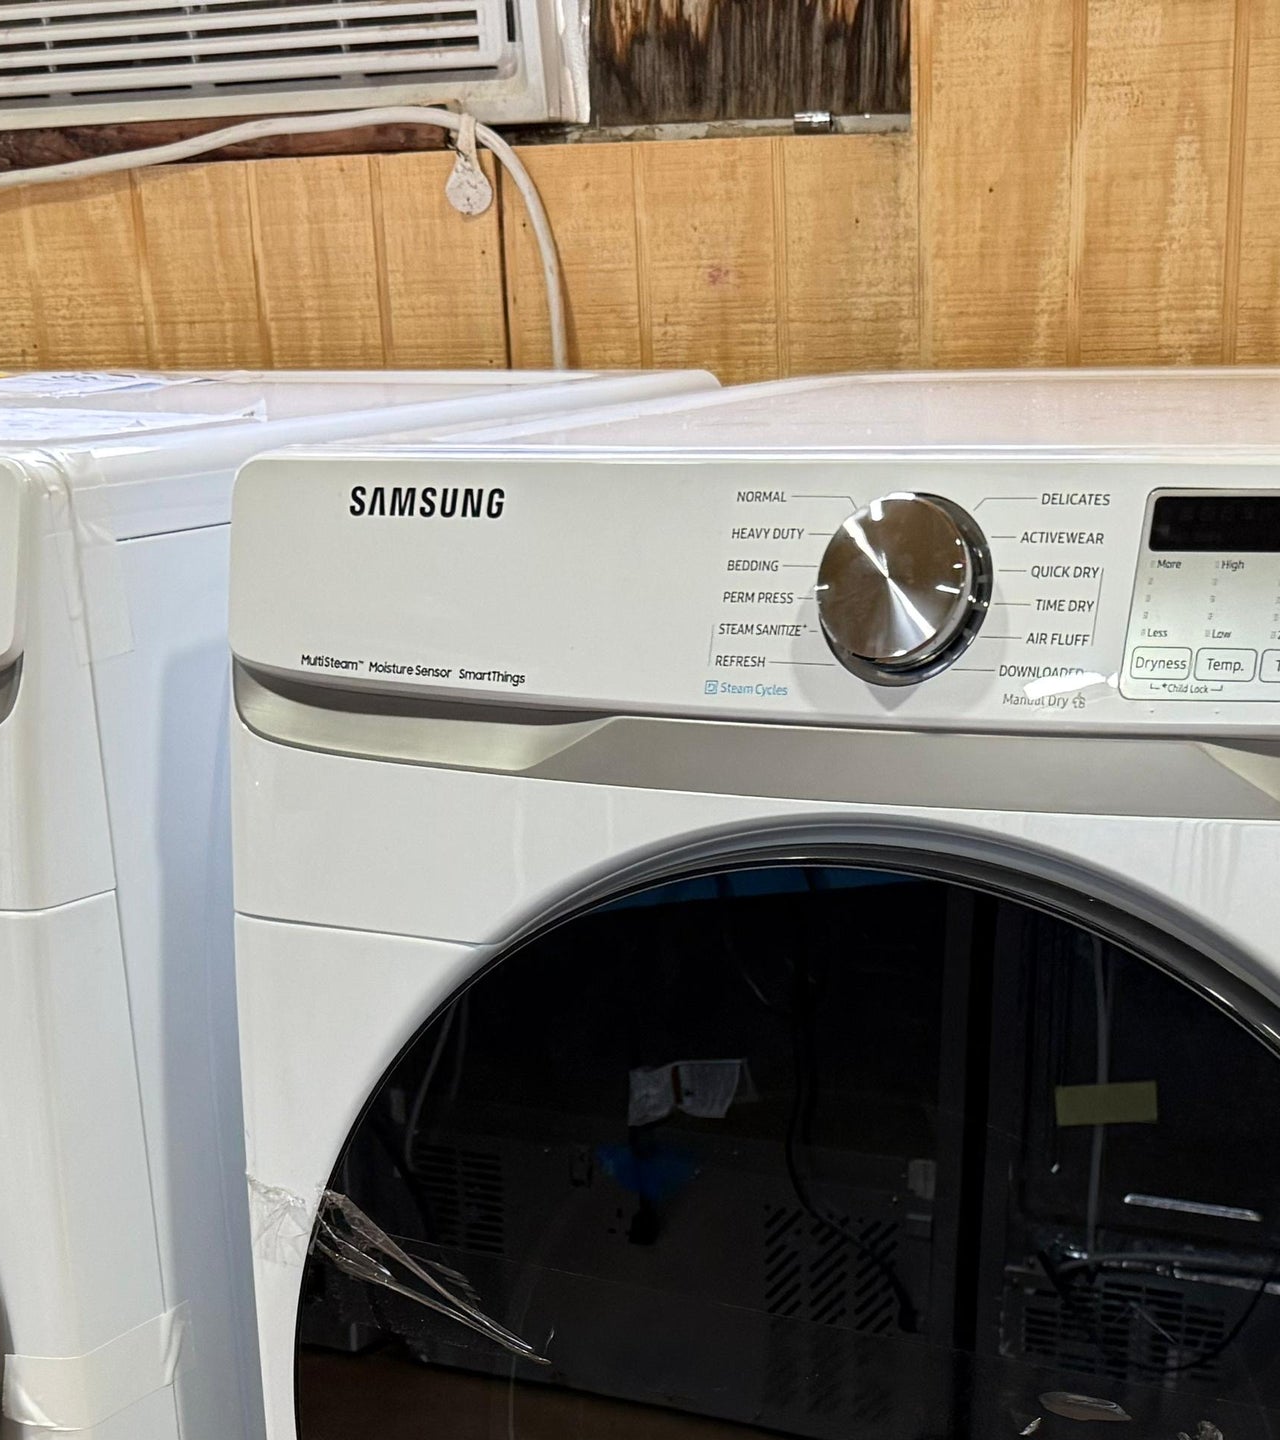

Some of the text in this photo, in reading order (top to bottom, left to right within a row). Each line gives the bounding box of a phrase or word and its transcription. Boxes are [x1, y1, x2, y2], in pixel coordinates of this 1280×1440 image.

[349, 486, 505, 518] SAMSUNG
[736, 491, 787, 503] NORMAL
[1041, 493, 1111, 506] DELICATES
[731, 528, 804, 539] HEAVY DUTY
[1020, 531, 1104, 544] ACTIVEWEAR
[727, 560, 779, 572] BEDDING
[1156, 560, 1182, 570] More
[1221, 560, 1245, 571] High
[1031, 565, 1100, 579] QUICK DRY
[723, 591, 794, 604] PERM PRESS
[1035, 599, 1095, 612] TIME DRY
[718, 623, 754, 636] STEAM
[1146, 628, 1168, 638] Less
[1212, 629, 1232, 639] Low
[1026, 632, 1091, 646] AIR FLUFF
[715, 655, 766, 668] REFRESH
[1135, 656, 1187, 671] Dryness
[1207, 657, 1245, 672] Temp.
[368, 661, 413, 676] Moisture
[415, 665, 452, 679] Sensor
[458, 669, 525, 687] SmartThings
[720, 682, 788, 697] Steam Cycles
[1190, 684, 1208, 695] Lock
[1002, 693, 1069, 709] Manual Dry
